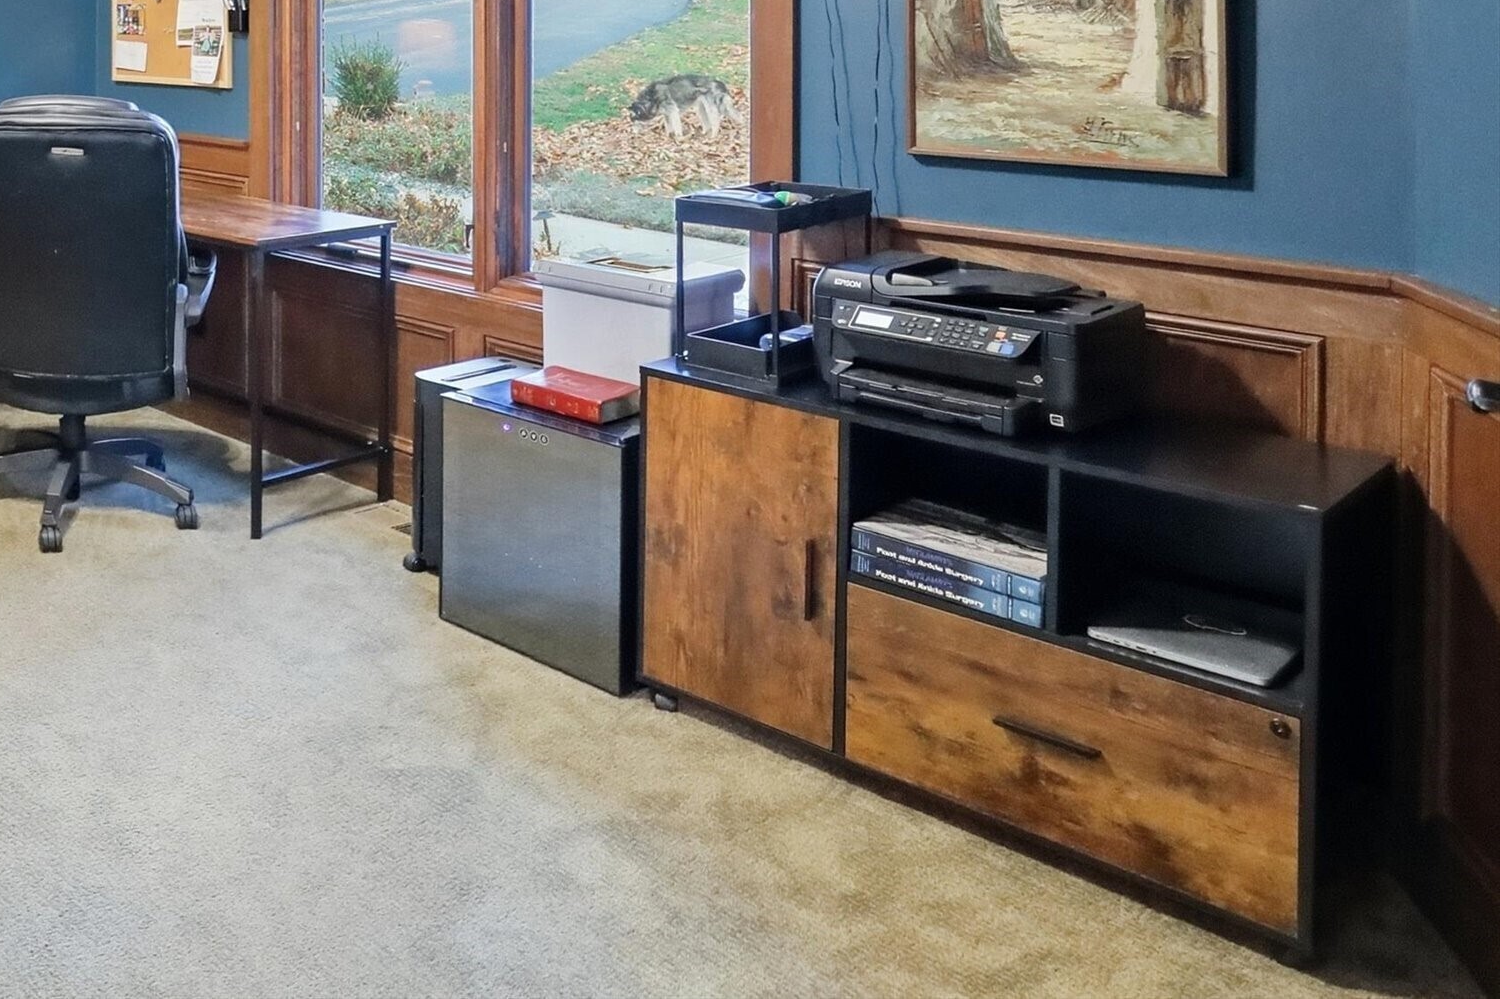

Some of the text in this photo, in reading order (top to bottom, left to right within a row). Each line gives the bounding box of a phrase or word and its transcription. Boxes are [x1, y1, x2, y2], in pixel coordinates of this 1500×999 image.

[834, 278, 862, 289] EPSON
[876, 546, 897, 559] Foot
[898, 554, 916, 565] and
[918, 559, 944, 573] Ankle
[944, 567, 984, 586] Surgery
[875, 569, 897, 582] Foot
[898, 578, 916, 588] and
[918, 582, 944, 596] Ankle
[945, 590, 984, 609] Surgery
